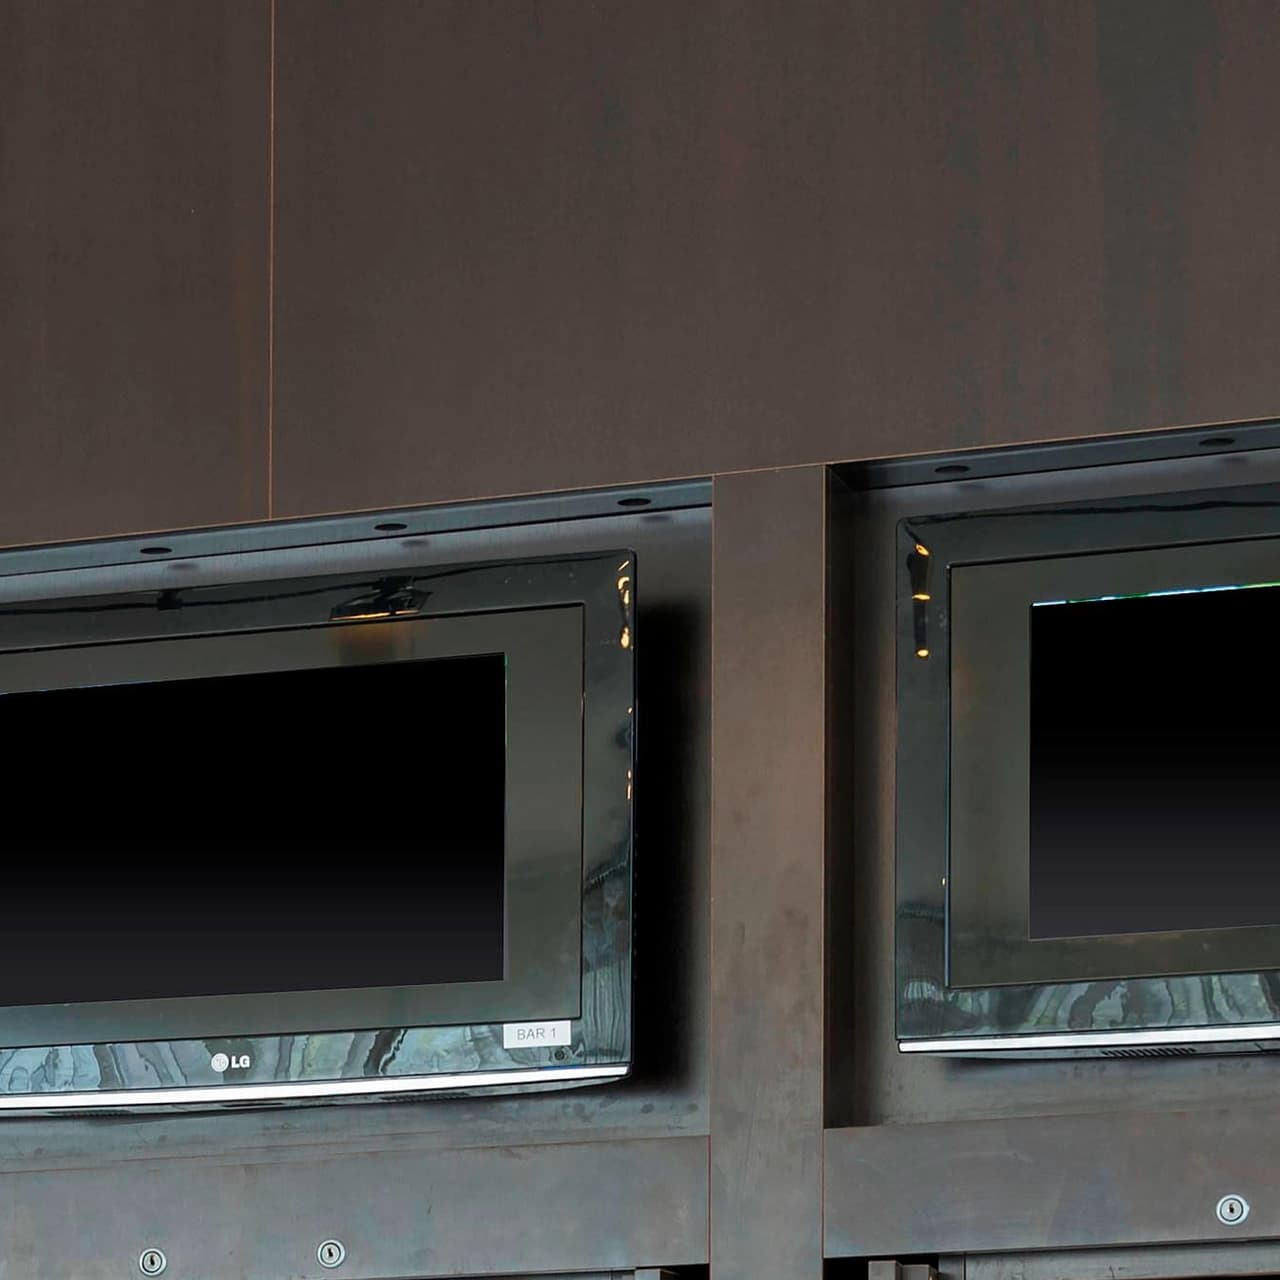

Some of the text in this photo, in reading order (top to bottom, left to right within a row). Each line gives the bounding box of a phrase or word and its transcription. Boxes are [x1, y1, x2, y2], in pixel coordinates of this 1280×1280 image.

[516, 1026, 557, 1042] BAR 1
[230, 1053, 250, 1069] LG
